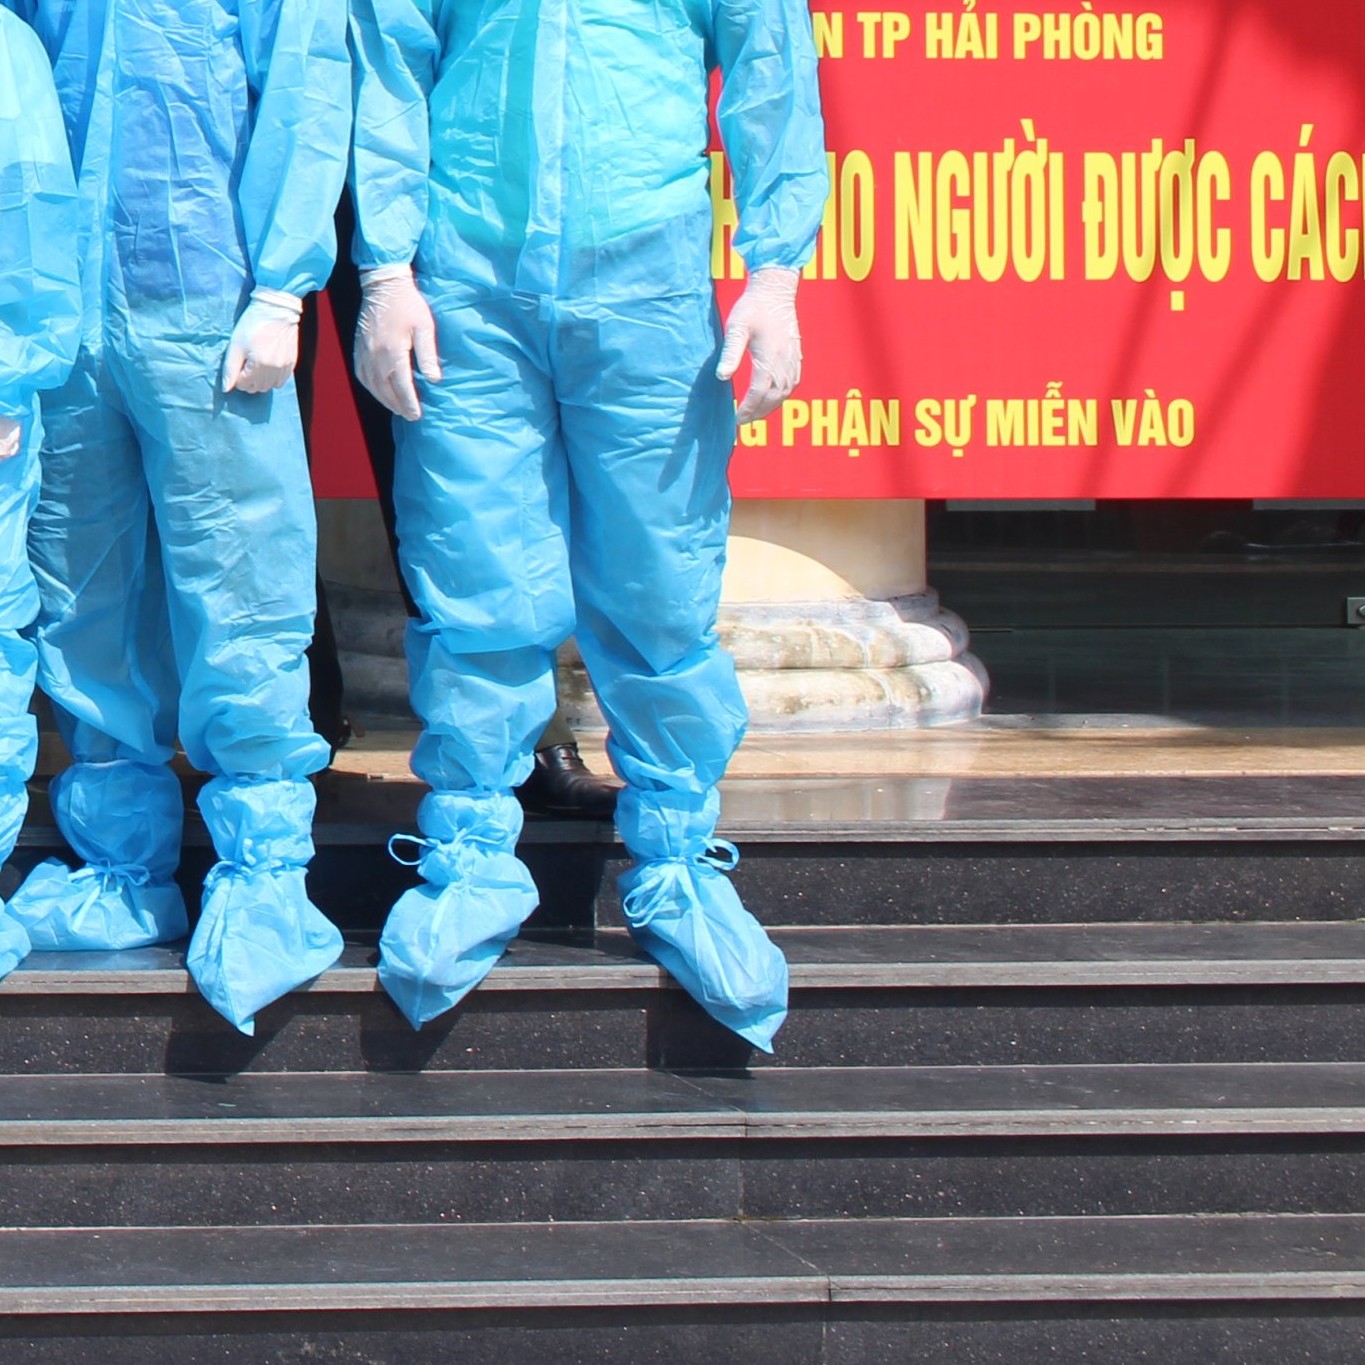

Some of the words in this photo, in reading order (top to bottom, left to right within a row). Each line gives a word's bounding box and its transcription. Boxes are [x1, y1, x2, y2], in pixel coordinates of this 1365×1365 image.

[857, 12, 911, 59] TP
[1013, 2, 1164, 60] PHÒNG
[894, 119, 1065, 282] NGƯỜI
[1082, 139, 1232, 311] ĐƯỢC
[1250, 124, 1365, 282] CÁC
[782, 389, 900, 457] PHẬN
[915, 394, 976, 457] SỰ
[986, 382, 1098, 447] MIỄN
[1111, 389, 1195, 447] VÀO
